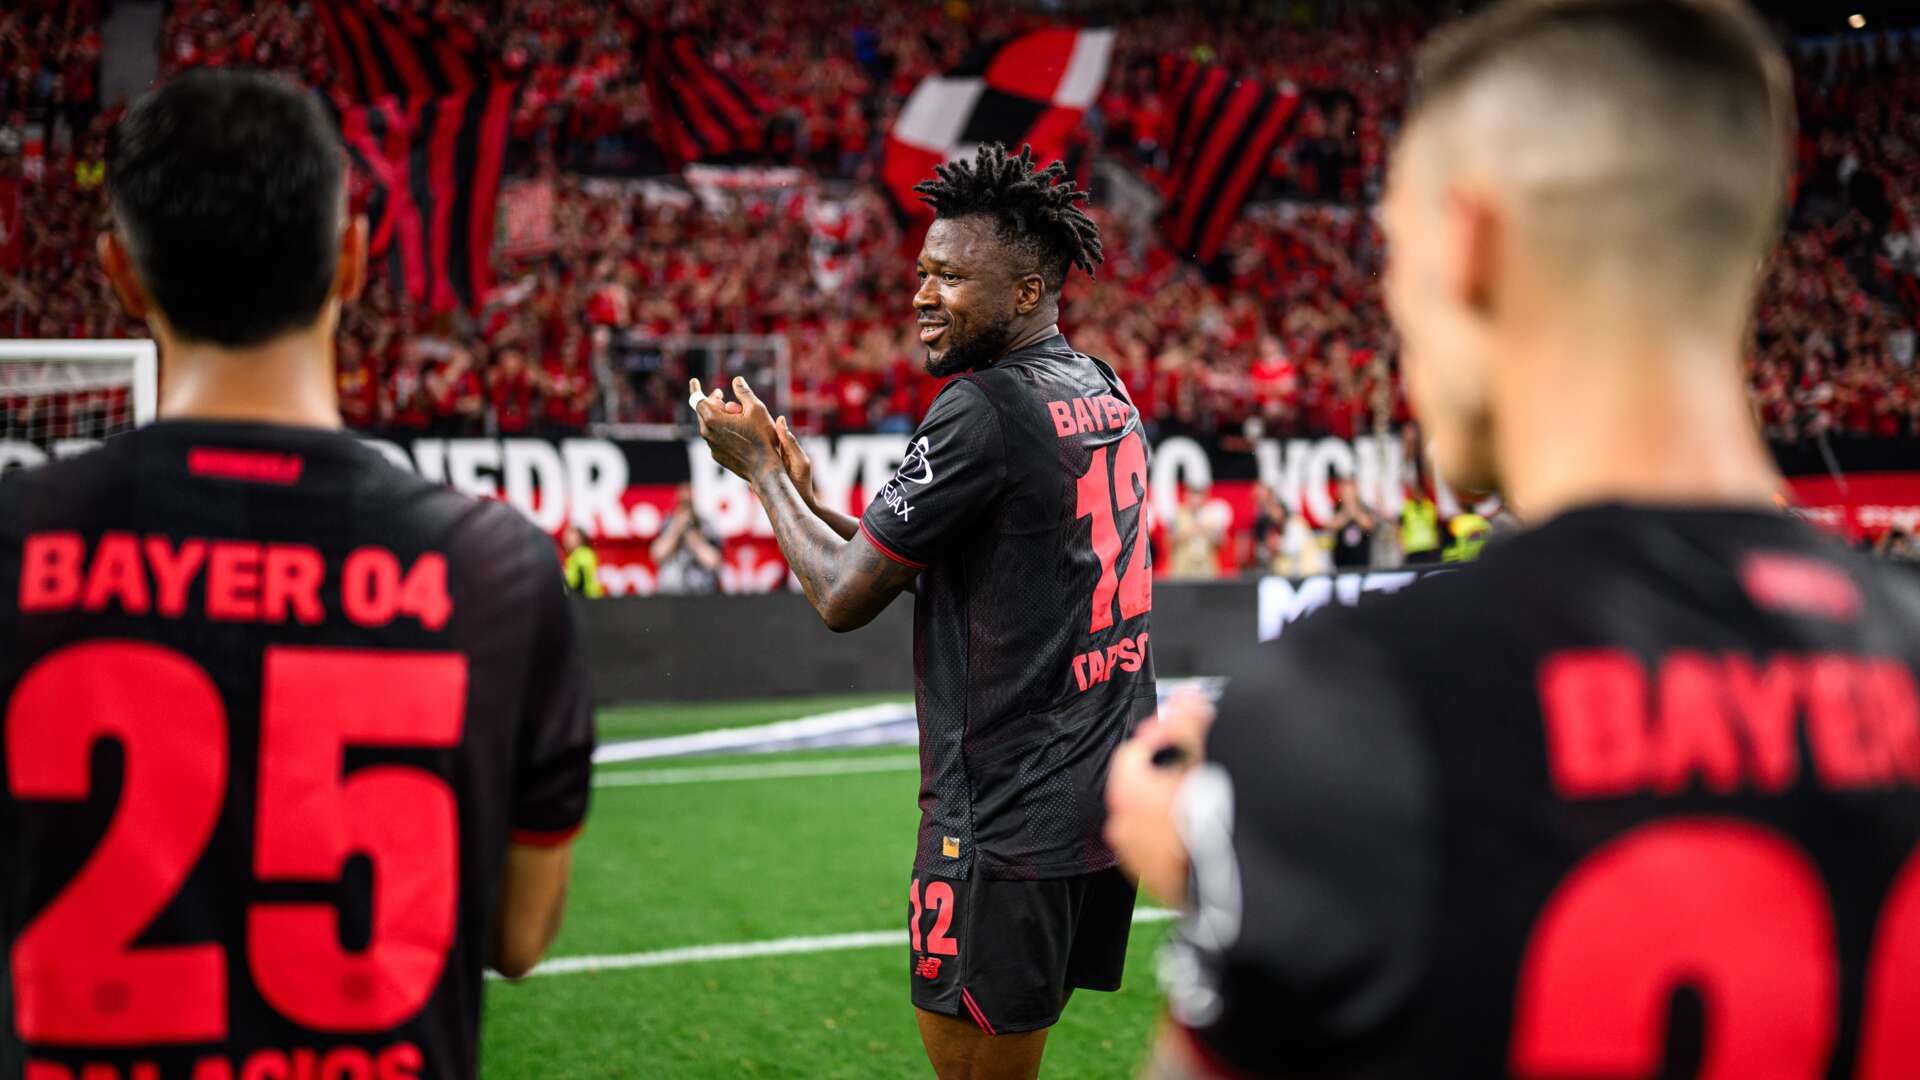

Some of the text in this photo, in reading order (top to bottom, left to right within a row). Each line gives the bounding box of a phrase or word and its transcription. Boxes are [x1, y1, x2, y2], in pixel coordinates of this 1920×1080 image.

[880, 482, 915, 522] EDAX
[1076, 431, 1152, 634] 12
[19, 531, 454, 631] BAYER 04
[6, 640, 468, 1047] 25
[909, 878, 958, 956] 12
